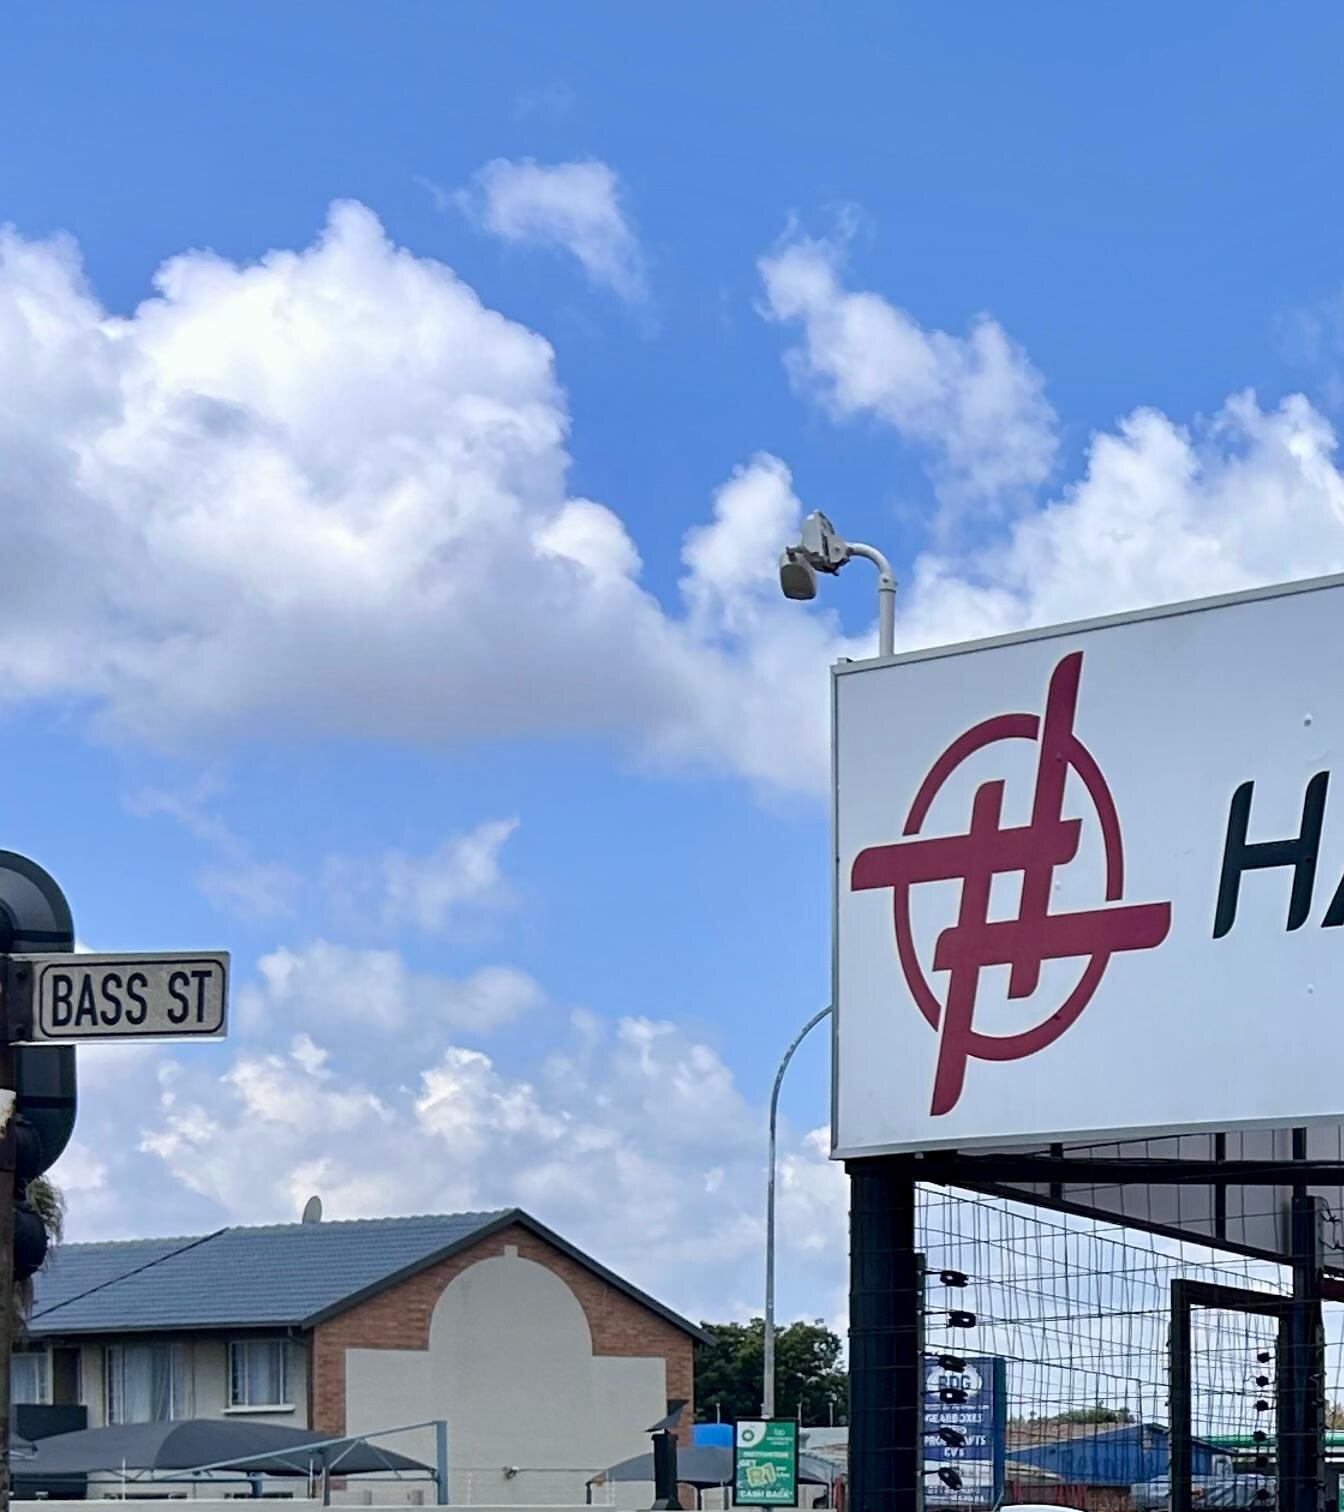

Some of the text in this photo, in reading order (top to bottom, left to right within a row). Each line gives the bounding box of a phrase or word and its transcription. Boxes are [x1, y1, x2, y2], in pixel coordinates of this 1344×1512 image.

[52, 970, 212, 1027] BASS ST
[740, 1489, 764, 1498] CASH
